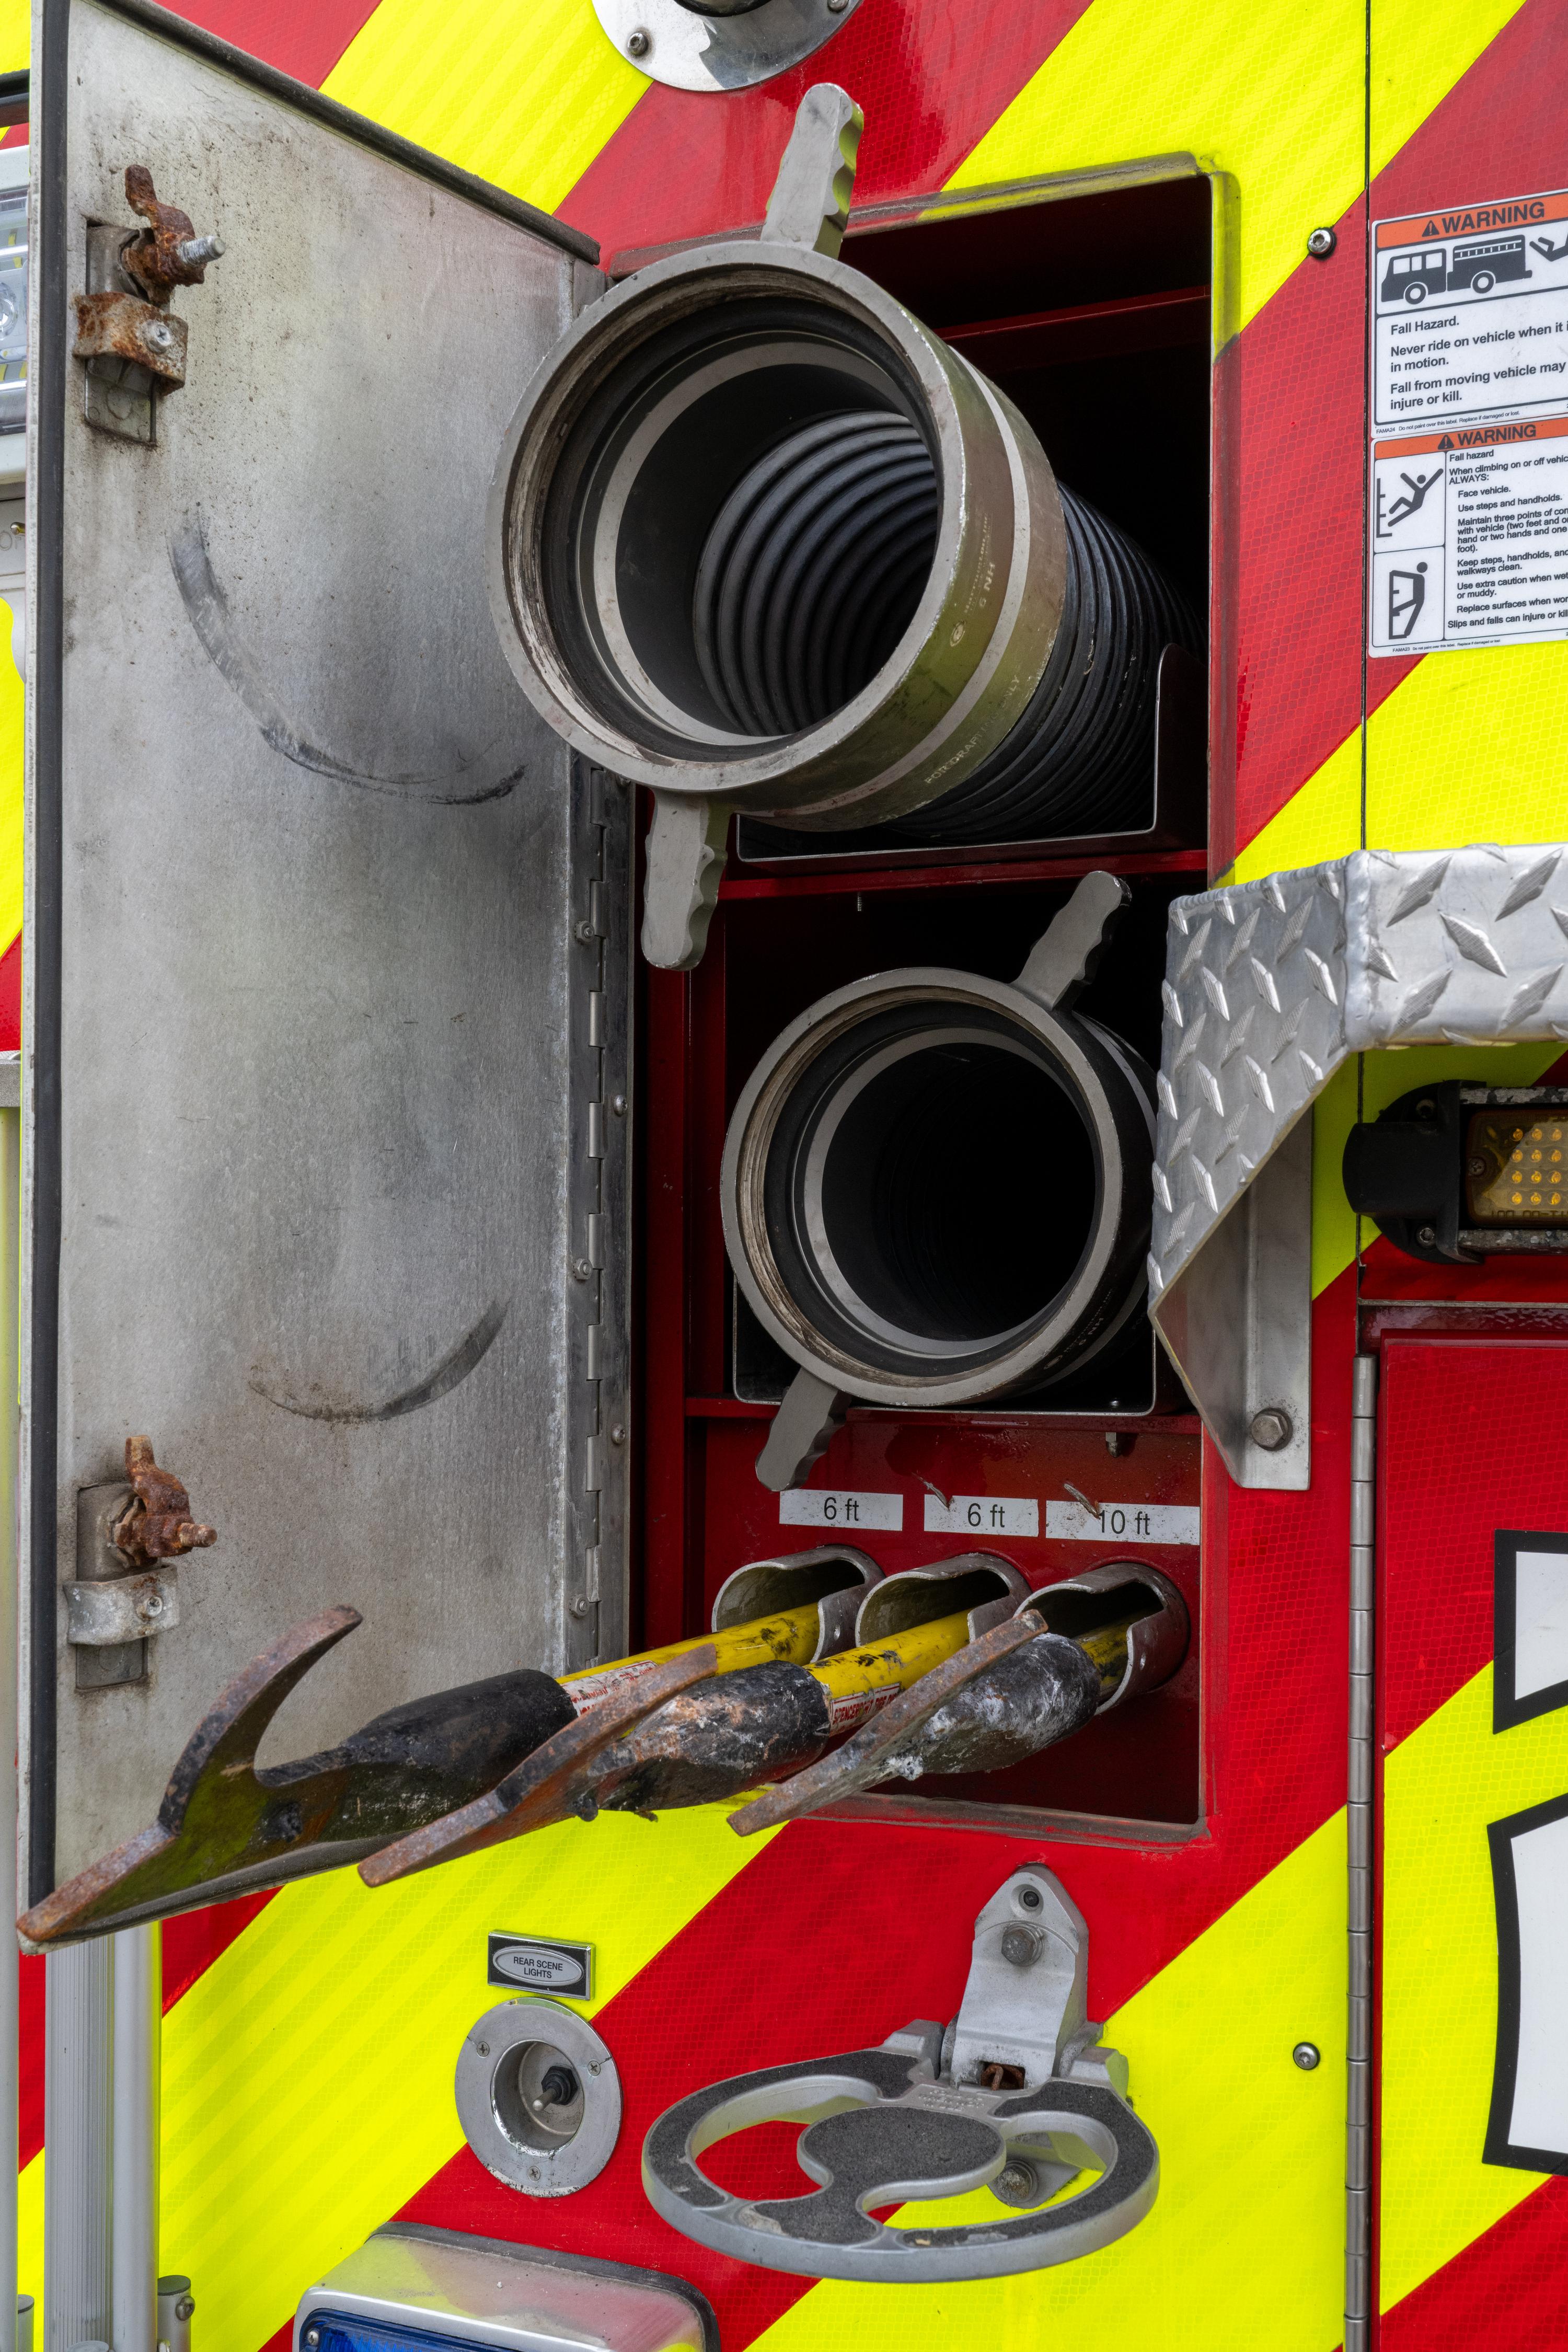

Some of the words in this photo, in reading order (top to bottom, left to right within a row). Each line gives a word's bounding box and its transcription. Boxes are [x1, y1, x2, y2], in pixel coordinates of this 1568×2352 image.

[1443, 202, 1544, 233] WARNING
[1391, 322, 1411, 335] Fall
[1415, 316, 1459, 331] Hazard.
[1391, 345, 1425, 356] Never
[1428, 340, 1450, 351] ride
[1454, 338, 1469, 347] on
[1472, 330, 1515, 344] vehicle
[1518, 326, 1551, 338] when
[1555, 322, 1563, 332] it
[1391, 363, 1401, 372] in
[1405, 357, 1448, 370] motion.
[1391, 382, 1411, 394] Fall
[1414, 380, 1442, 390] from
[1446, 373, 1490, 386] moving
[1494, 365, 1536, 379] vehicle
[1540, 362, 1566, 373] may
[1391, 398, 1423, 411] injure
[1427, 396, 1439, 404] or
[1443, 390, 1462, 402] kill.
[1458, 424, 1536, 445] WARNING
[1450, 453, 1464, 462] Fall
[1467, 449, 1494, 460] hazard
[1475, 463, 1508, 472] climbing
[1449, 474, 1489, 485] ALWAYS:
[1480, 486, 1511, 495] vehicle.
[1500, 499, 1515, 507] and
[1518, 493, 1562, 505] handholds.
[1458, 516, 1492, 526] Maintain
[1517, 511, 1542, 521] points
[1544, 508, 1552, 516] of
[1457, 526, 1473, 535] with
[1476, 523, 1504, 533] vehicle
[1507, 522, 1524, 531] (two
[1544, 517, 1559, 525] and
[1458, 535, 1477, 544] hand
[1507, 529, 1531, 538] hands
[1534, 527, 1549, 535] and
[1457, 544, 1478, 553] foot).
[1507, 550, 1551, 561] handholds,
[1457, 567, 1496, 576] walkways
[1498, 563, 1522, 572] clean.
[1498, 577, 1527, 585] caution
[1554, 572, 1568, 580] wet
[1468, 589, 1496, 598] muddy.
[1457, 604, 1490, 614] Replace
[1492, 601, 1527, 609] surfaces
[1448, 620, 1467, 629] Slips
[1469, 618, 1484, 626] and
[1523, 613, 1546, 622] injure
[824, 1497, 837, 1520] 6
[845, 1498, 859, 1521] ft
[968, 1503, 981, 1527] 6
[990, 1504, 1005, 1528] ft
[1099, 1510, 1125, 1534] 10
[1135, 1511, 1150, 1535] ft
[514, 1956, 534, 1966] REAR
[537, 1960, 563, 1971] SCENE
[524, 1967, 552, 1978] LIGHTS
